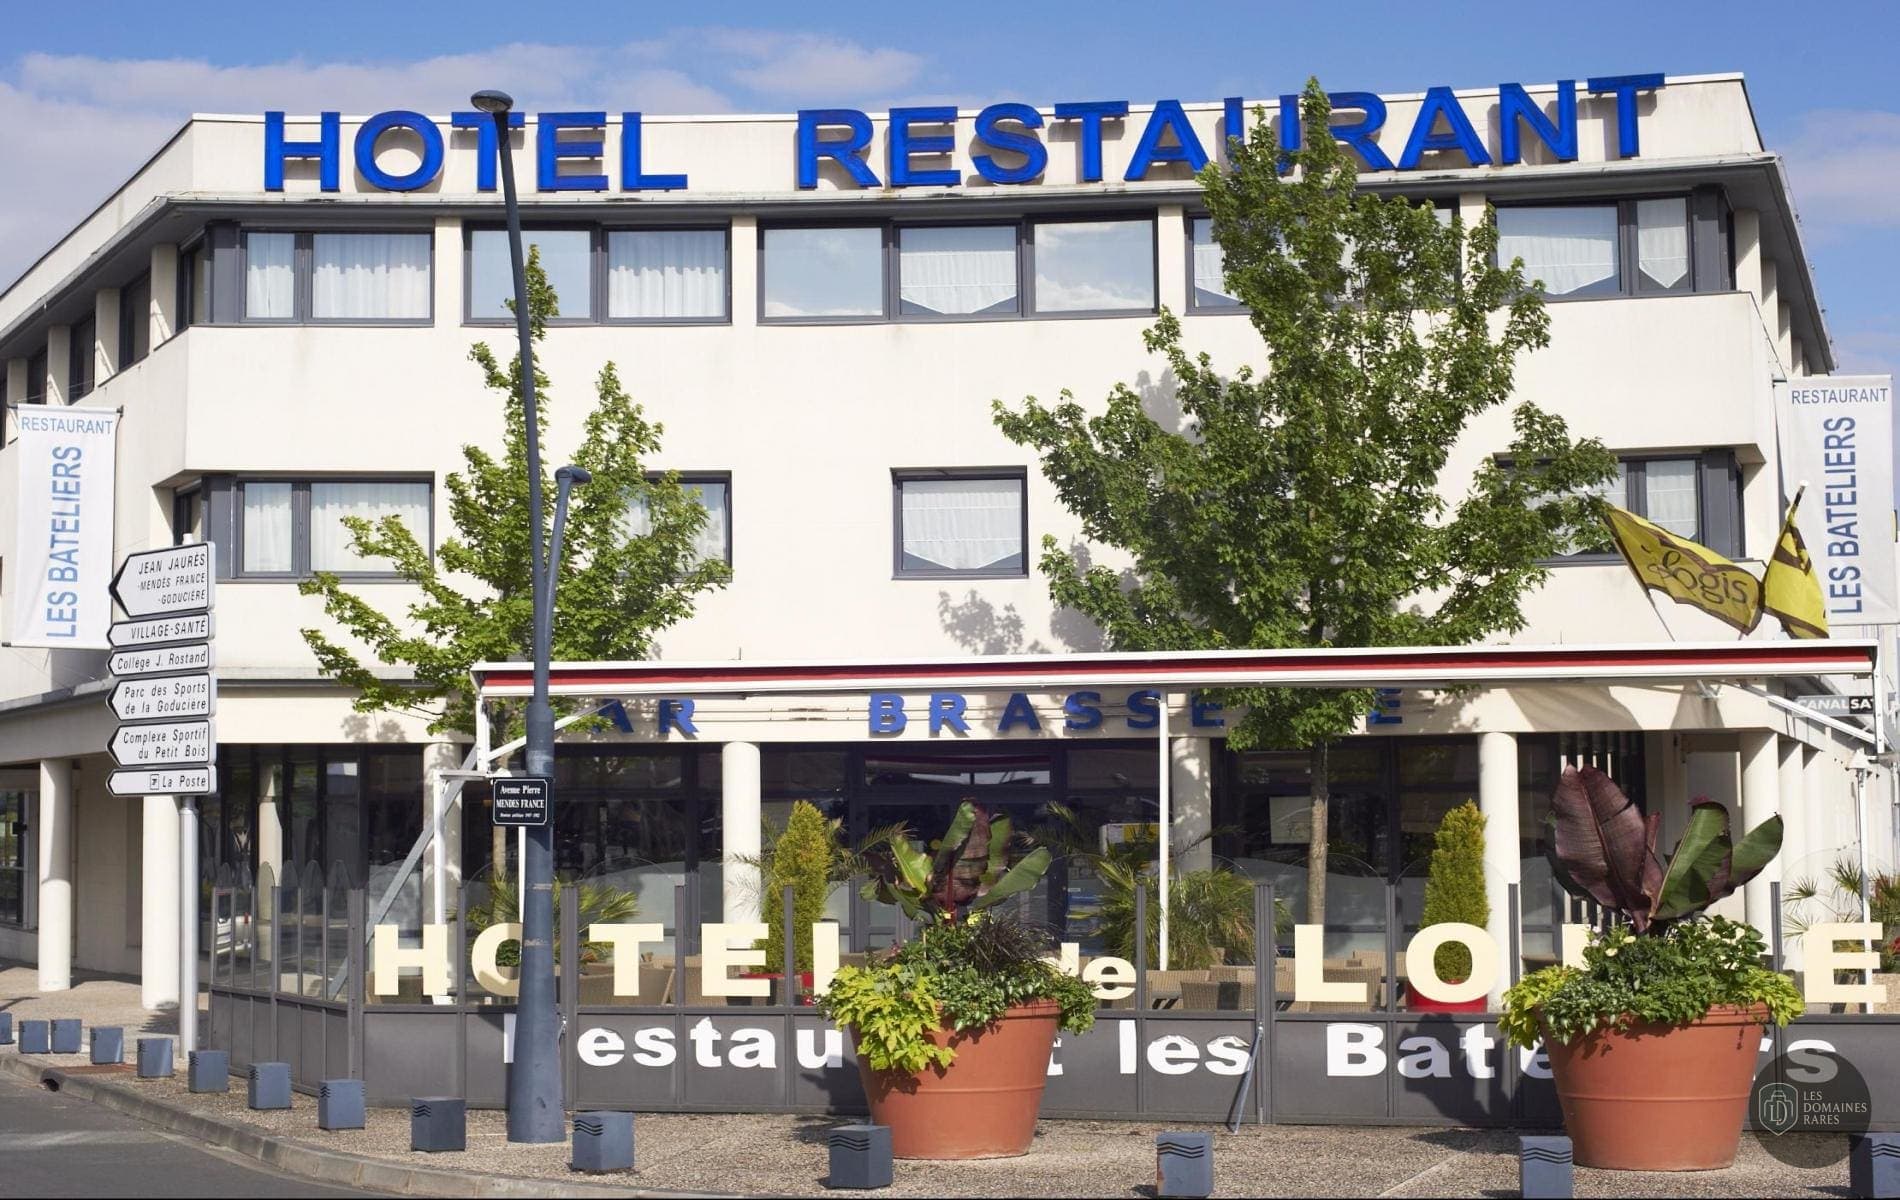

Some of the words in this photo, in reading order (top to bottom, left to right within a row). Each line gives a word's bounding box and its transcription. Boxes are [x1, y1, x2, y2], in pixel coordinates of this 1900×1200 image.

[264, 111, 688, 192] HOTEL
[797, 73, 1665, 190] RESTAURANT
[1791, 388, 1888, 404] RESTAURANT
[21, 416, 113, 434] RESTAURANT
[1823, 416, 1859, 557] BATELIERS
[48, 446, 82, 583] BATELIERS
[138, 560, 162, 575] JEAN
[175, 572, 206, 586] FRANCE
[1828, 566, 1863, 614] LES
[46, 591, 78, 638] LES
[168, 650, 206, 665] Rostand
[124, 686, 145, 698] Parc
[151, 685, 167, 697] des
[174, 682, 206, 696] Sports
[125, 704, 136, 715] de
[141, 701, 150, 713] la
[868, 689, 1402, 733] BRASSEE
[123, 731, 167, 745] Complexe
[172, 728, 207, 744] Sportif
[138, 747, 149, 759] du
[155, 746, 178, 758] Petit
[185, 744, 206, 757] Bois
[162, 776, 173, 788] La
[179, 774, 206, 787] Poste
[520, 799, 545, 808] FRANCE
[1119, 1019, 1250, 1076] les
